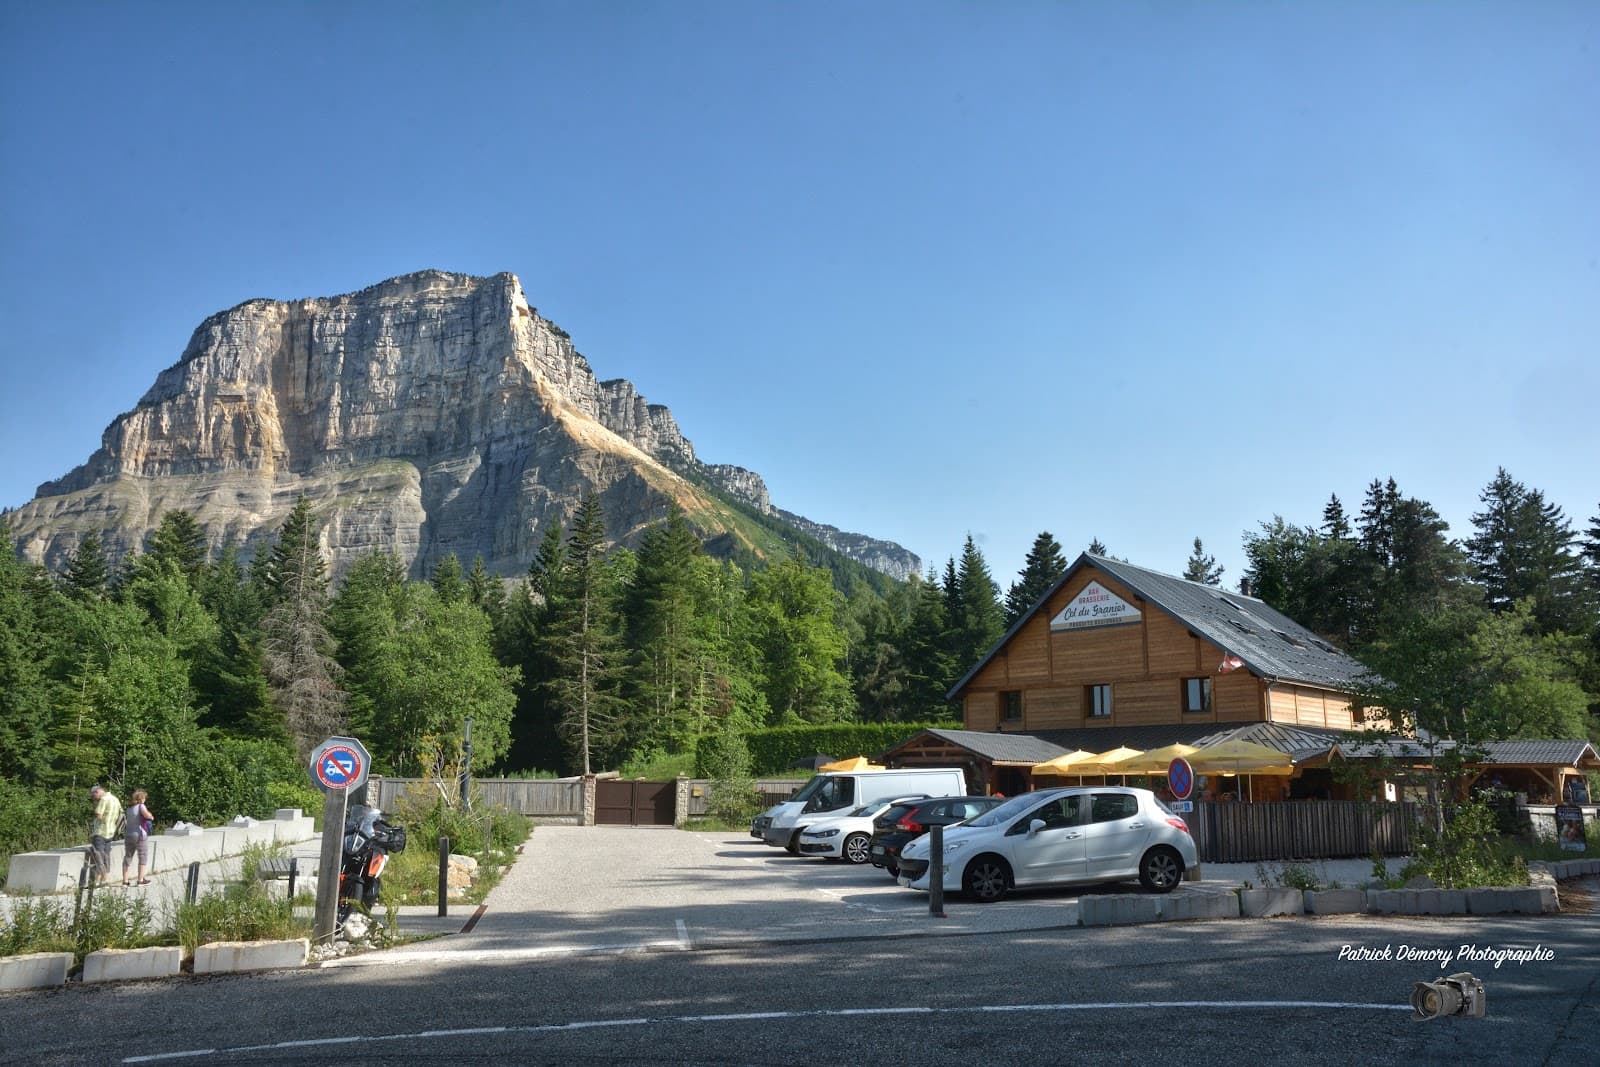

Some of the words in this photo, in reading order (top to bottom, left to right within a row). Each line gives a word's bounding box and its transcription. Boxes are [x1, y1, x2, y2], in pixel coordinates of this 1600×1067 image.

[1078, 594, 1110, 604] BRASSERIE
[1064, 607, 1076, 620] Col
[1078, 606, 1090, 616] du
[1092, 602, 1126, 616] Granier
